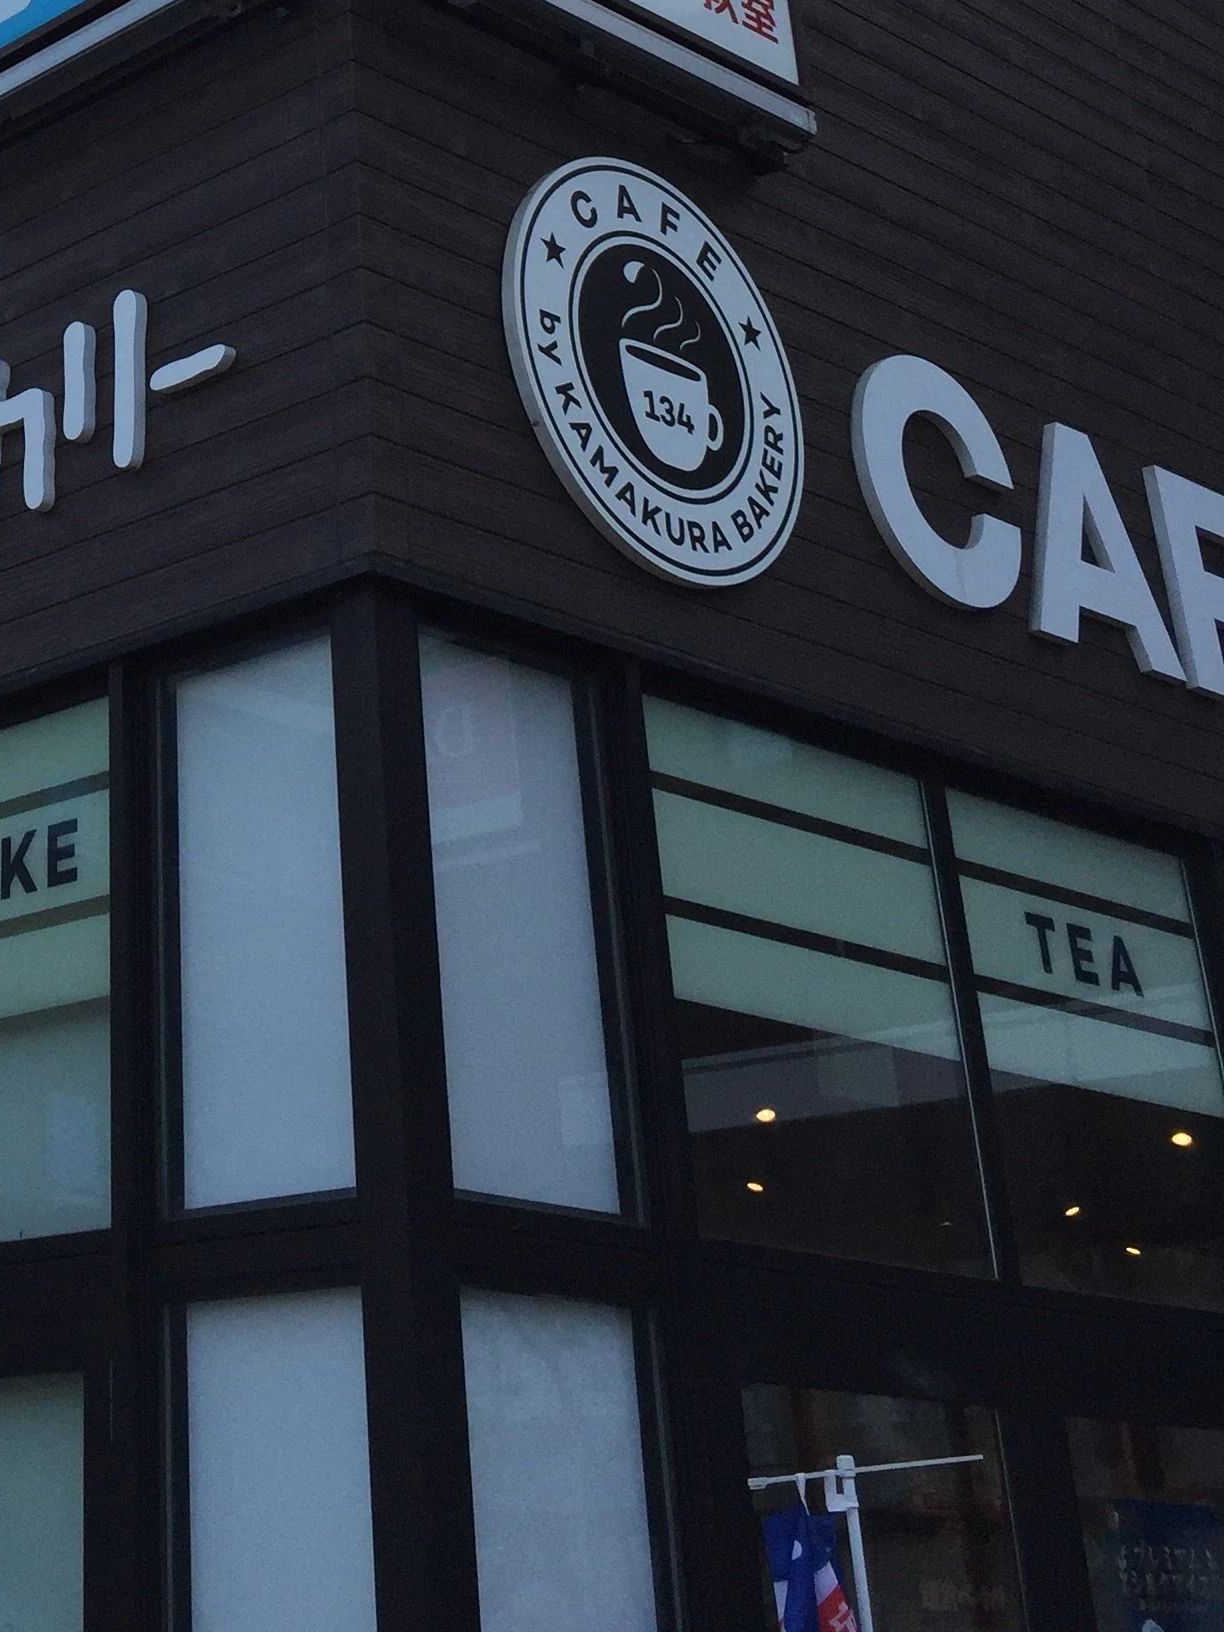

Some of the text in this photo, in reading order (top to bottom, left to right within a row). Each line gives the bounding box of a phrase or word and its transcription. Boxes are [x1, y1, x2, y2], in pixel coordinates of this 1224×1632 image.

[570, 184, 723, 282] CAFE
[537, 308, 784, 555] by KAMAKURA BAKERY
[642, 389, 695, 436] 134
[1024, 911, 1145, 998] TEA
